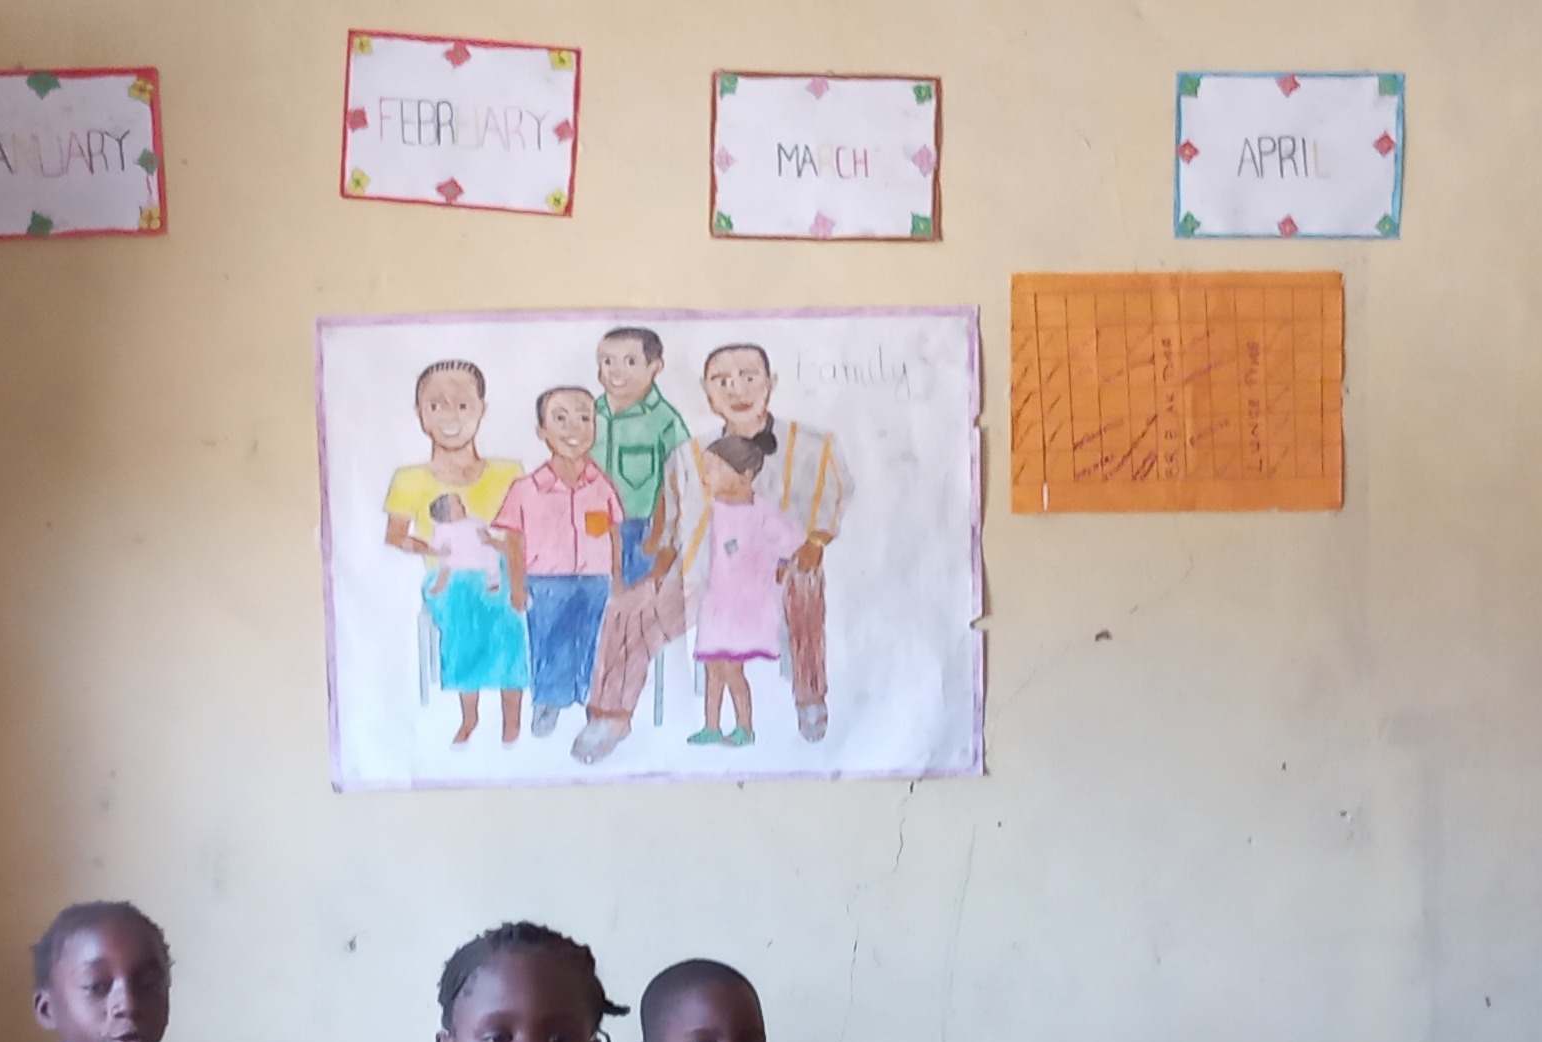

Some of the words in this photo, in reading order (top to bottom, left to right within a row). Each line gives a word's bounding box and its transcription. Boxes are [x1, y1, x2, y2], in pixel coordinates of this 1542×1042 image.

[378, 96, 551, 152] FEBRUARY
[776, 142, 869, 179] MARCH
[1237, 135, 1331, 179] APRIL
